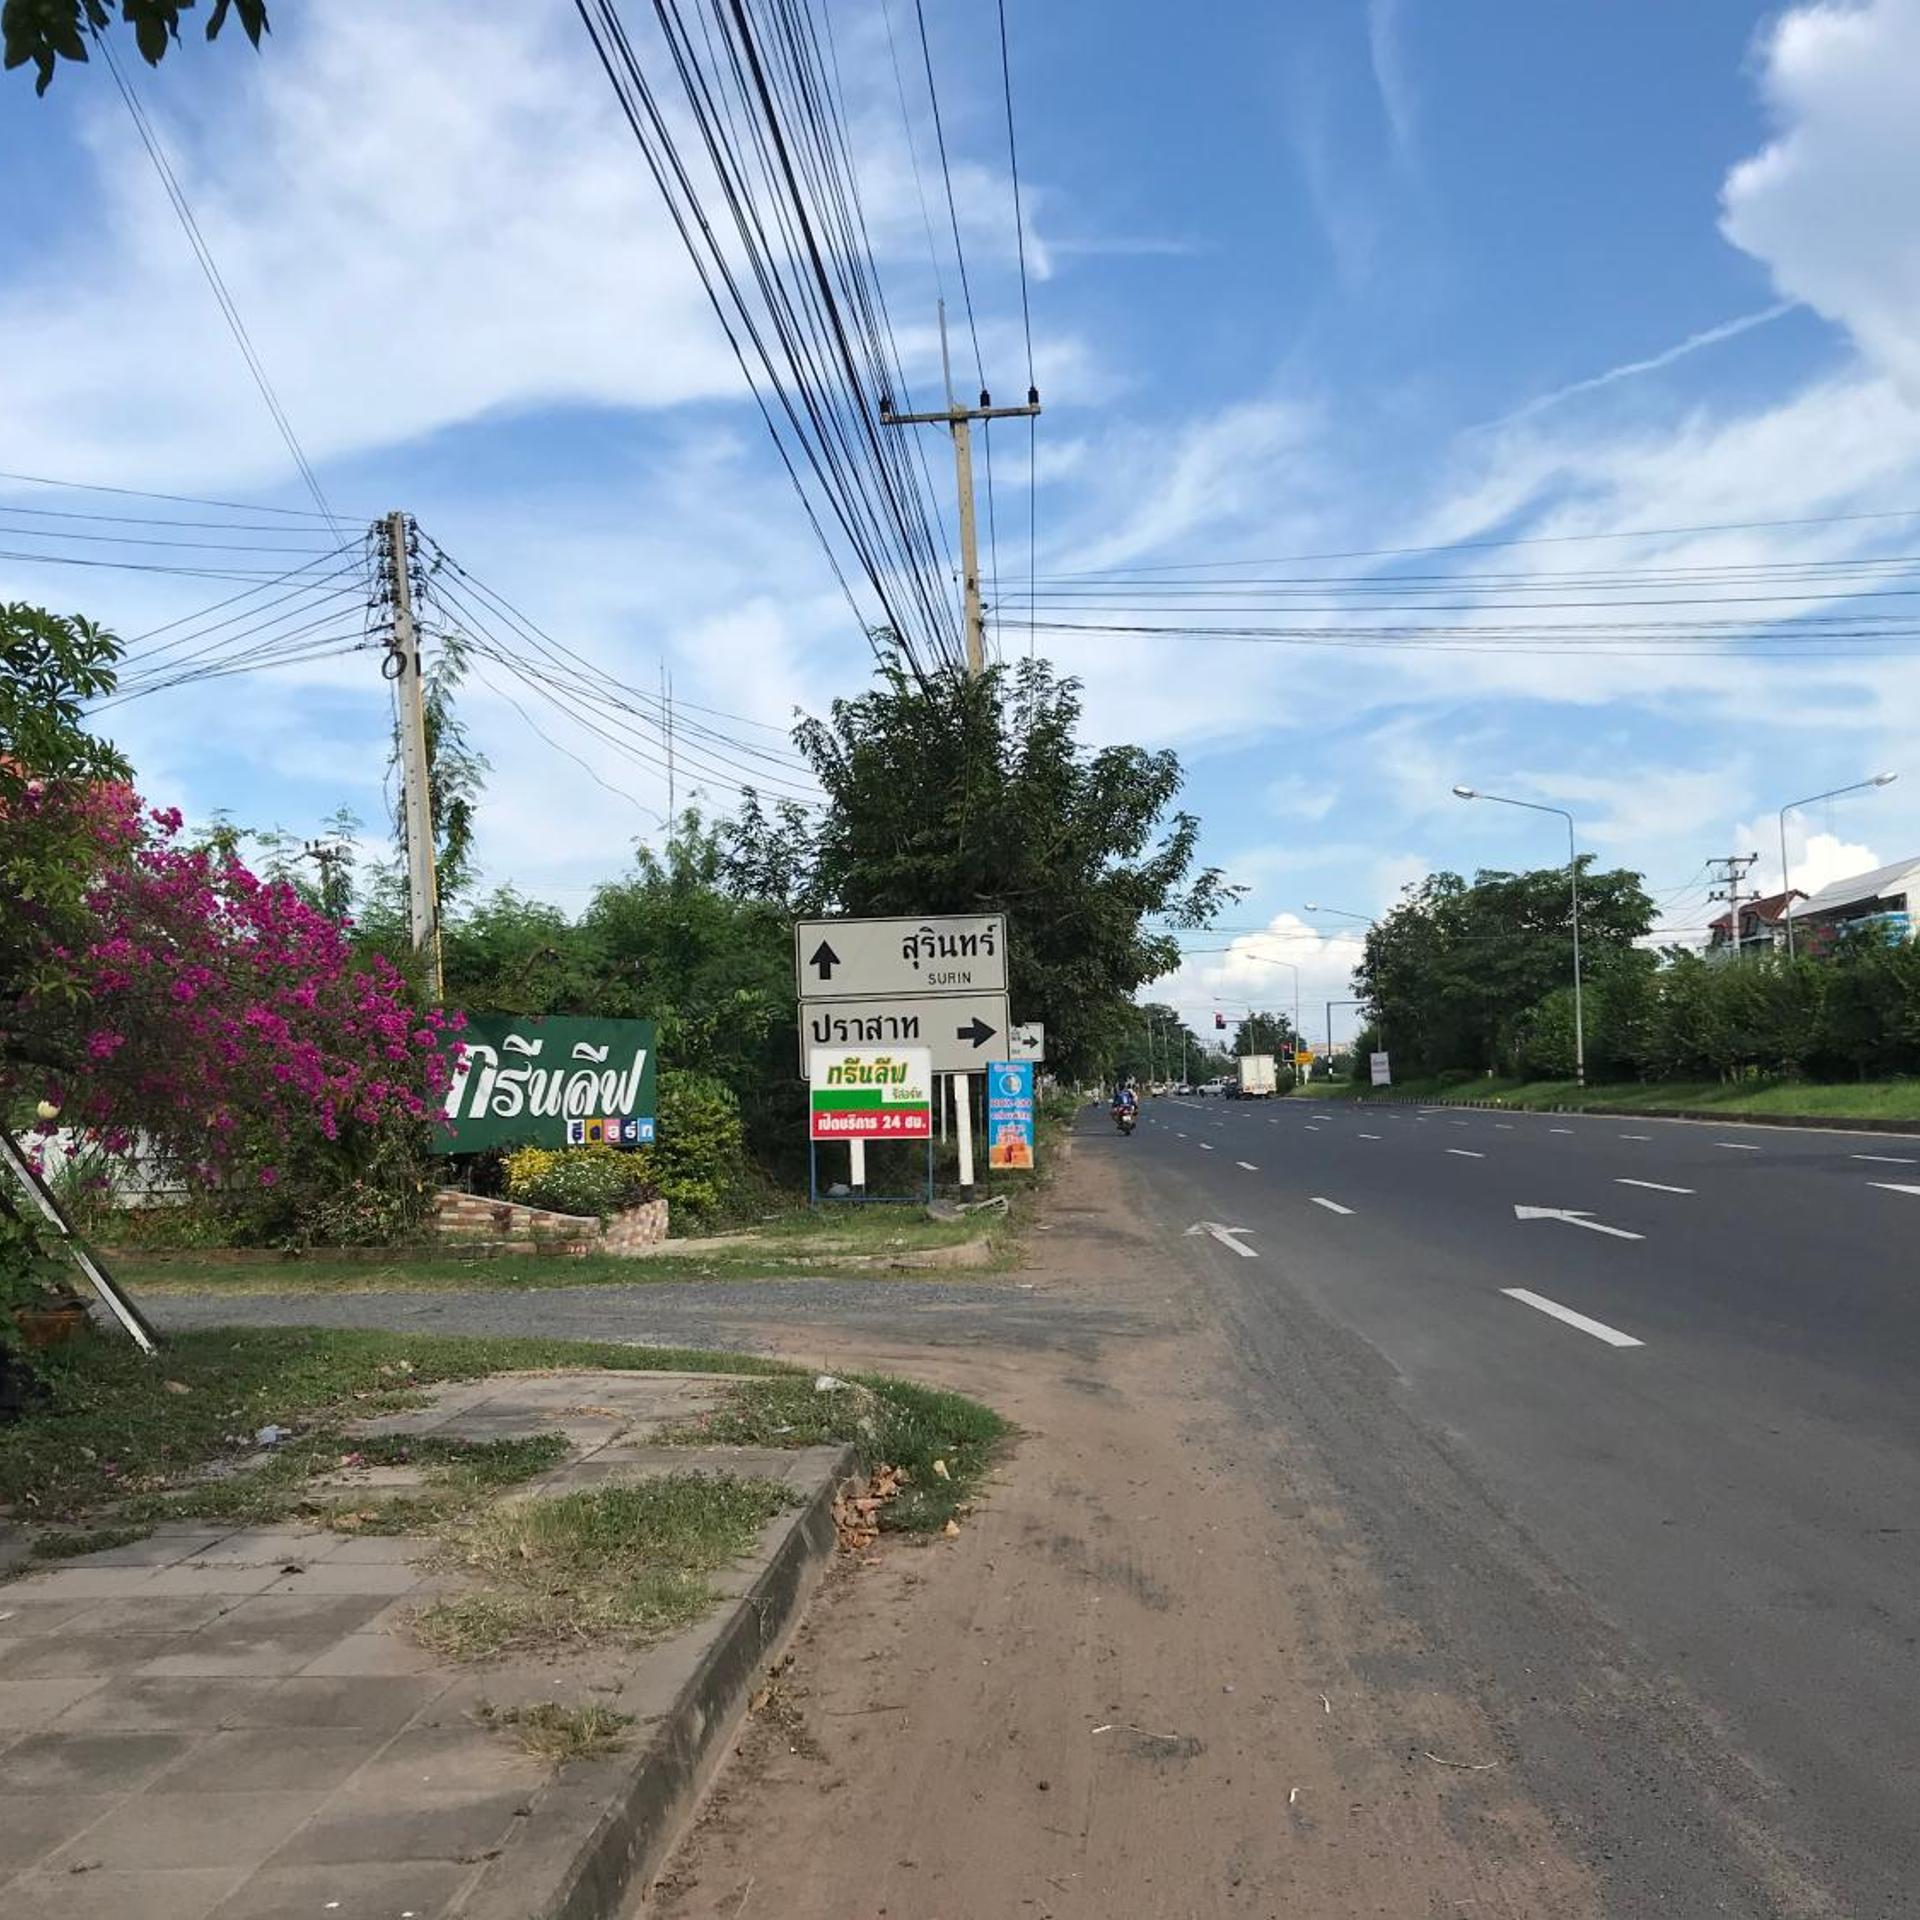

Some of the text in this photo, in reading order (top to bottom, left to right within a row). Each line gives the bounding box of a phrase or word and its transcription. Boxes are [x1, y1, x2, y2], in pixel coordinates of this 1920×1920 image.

[902, 925, 997, 970] สุรินทร์
[928, 971, 972, 985] SURIN
[811, 1013, 920, 1043] ปราสาท
[444, 1033, 647, 1121] กรีนลีฟ
[817, 1113, 927, 1131] เปิดบริการ 24 ชม.
